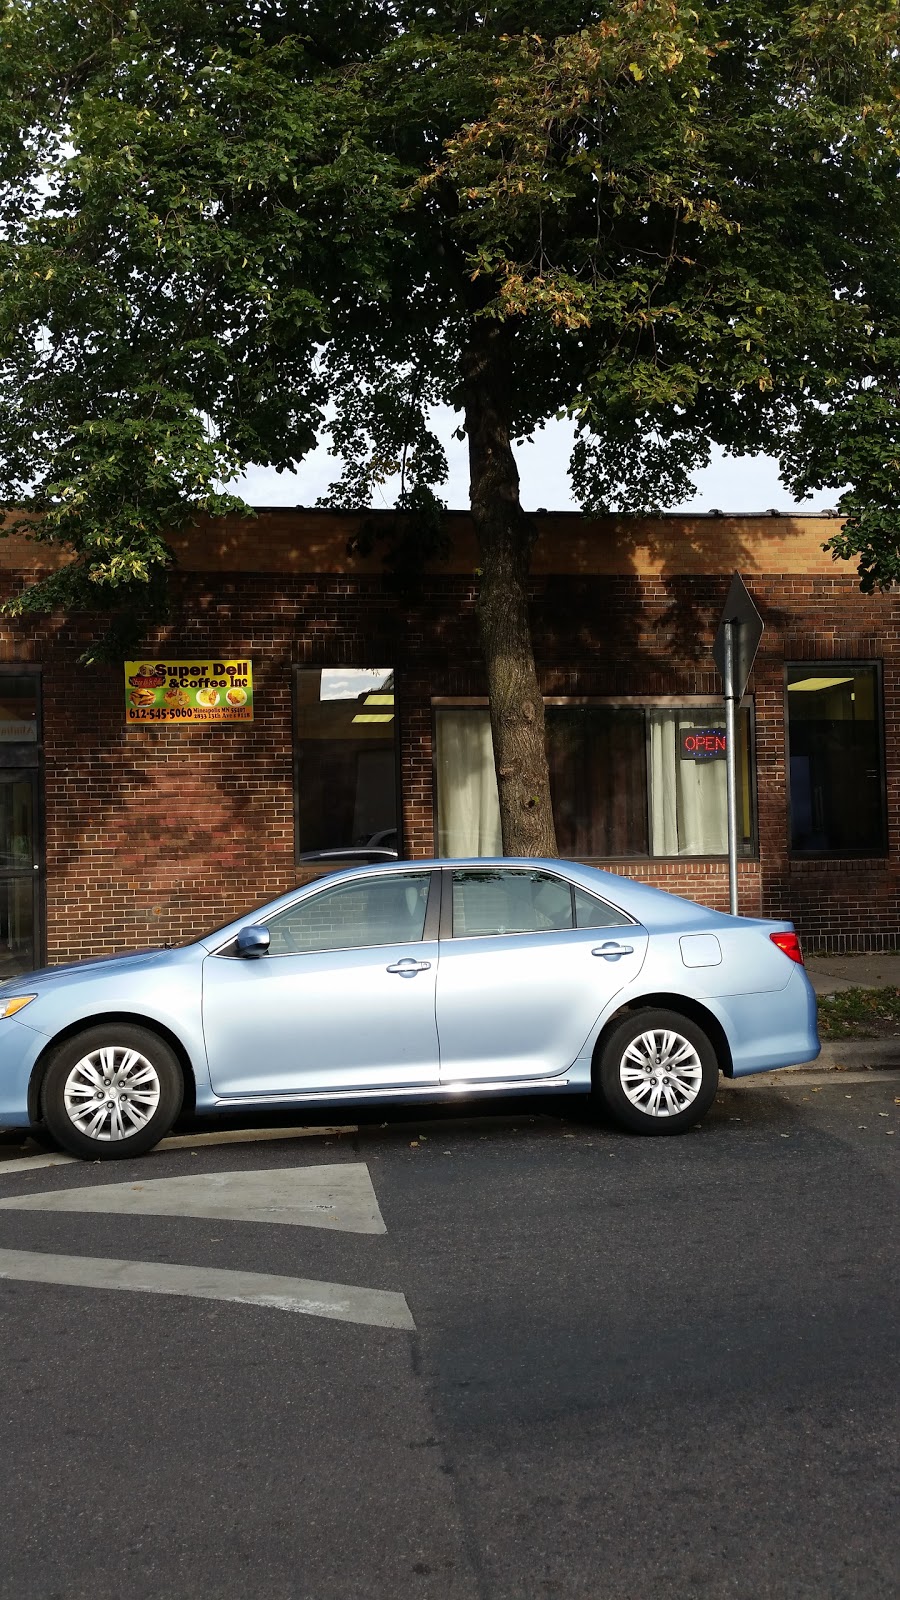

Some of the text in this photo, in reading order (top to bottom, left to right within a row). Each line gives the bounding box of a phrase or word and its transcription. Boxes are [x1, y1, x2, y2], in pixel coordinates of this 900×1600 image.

[155, 664, 208, 678] Super
[168, 678, 227, 688] &Coffee
[230, 675, 248, 688] Inc
[685, 736, 726, 750] OPEN
